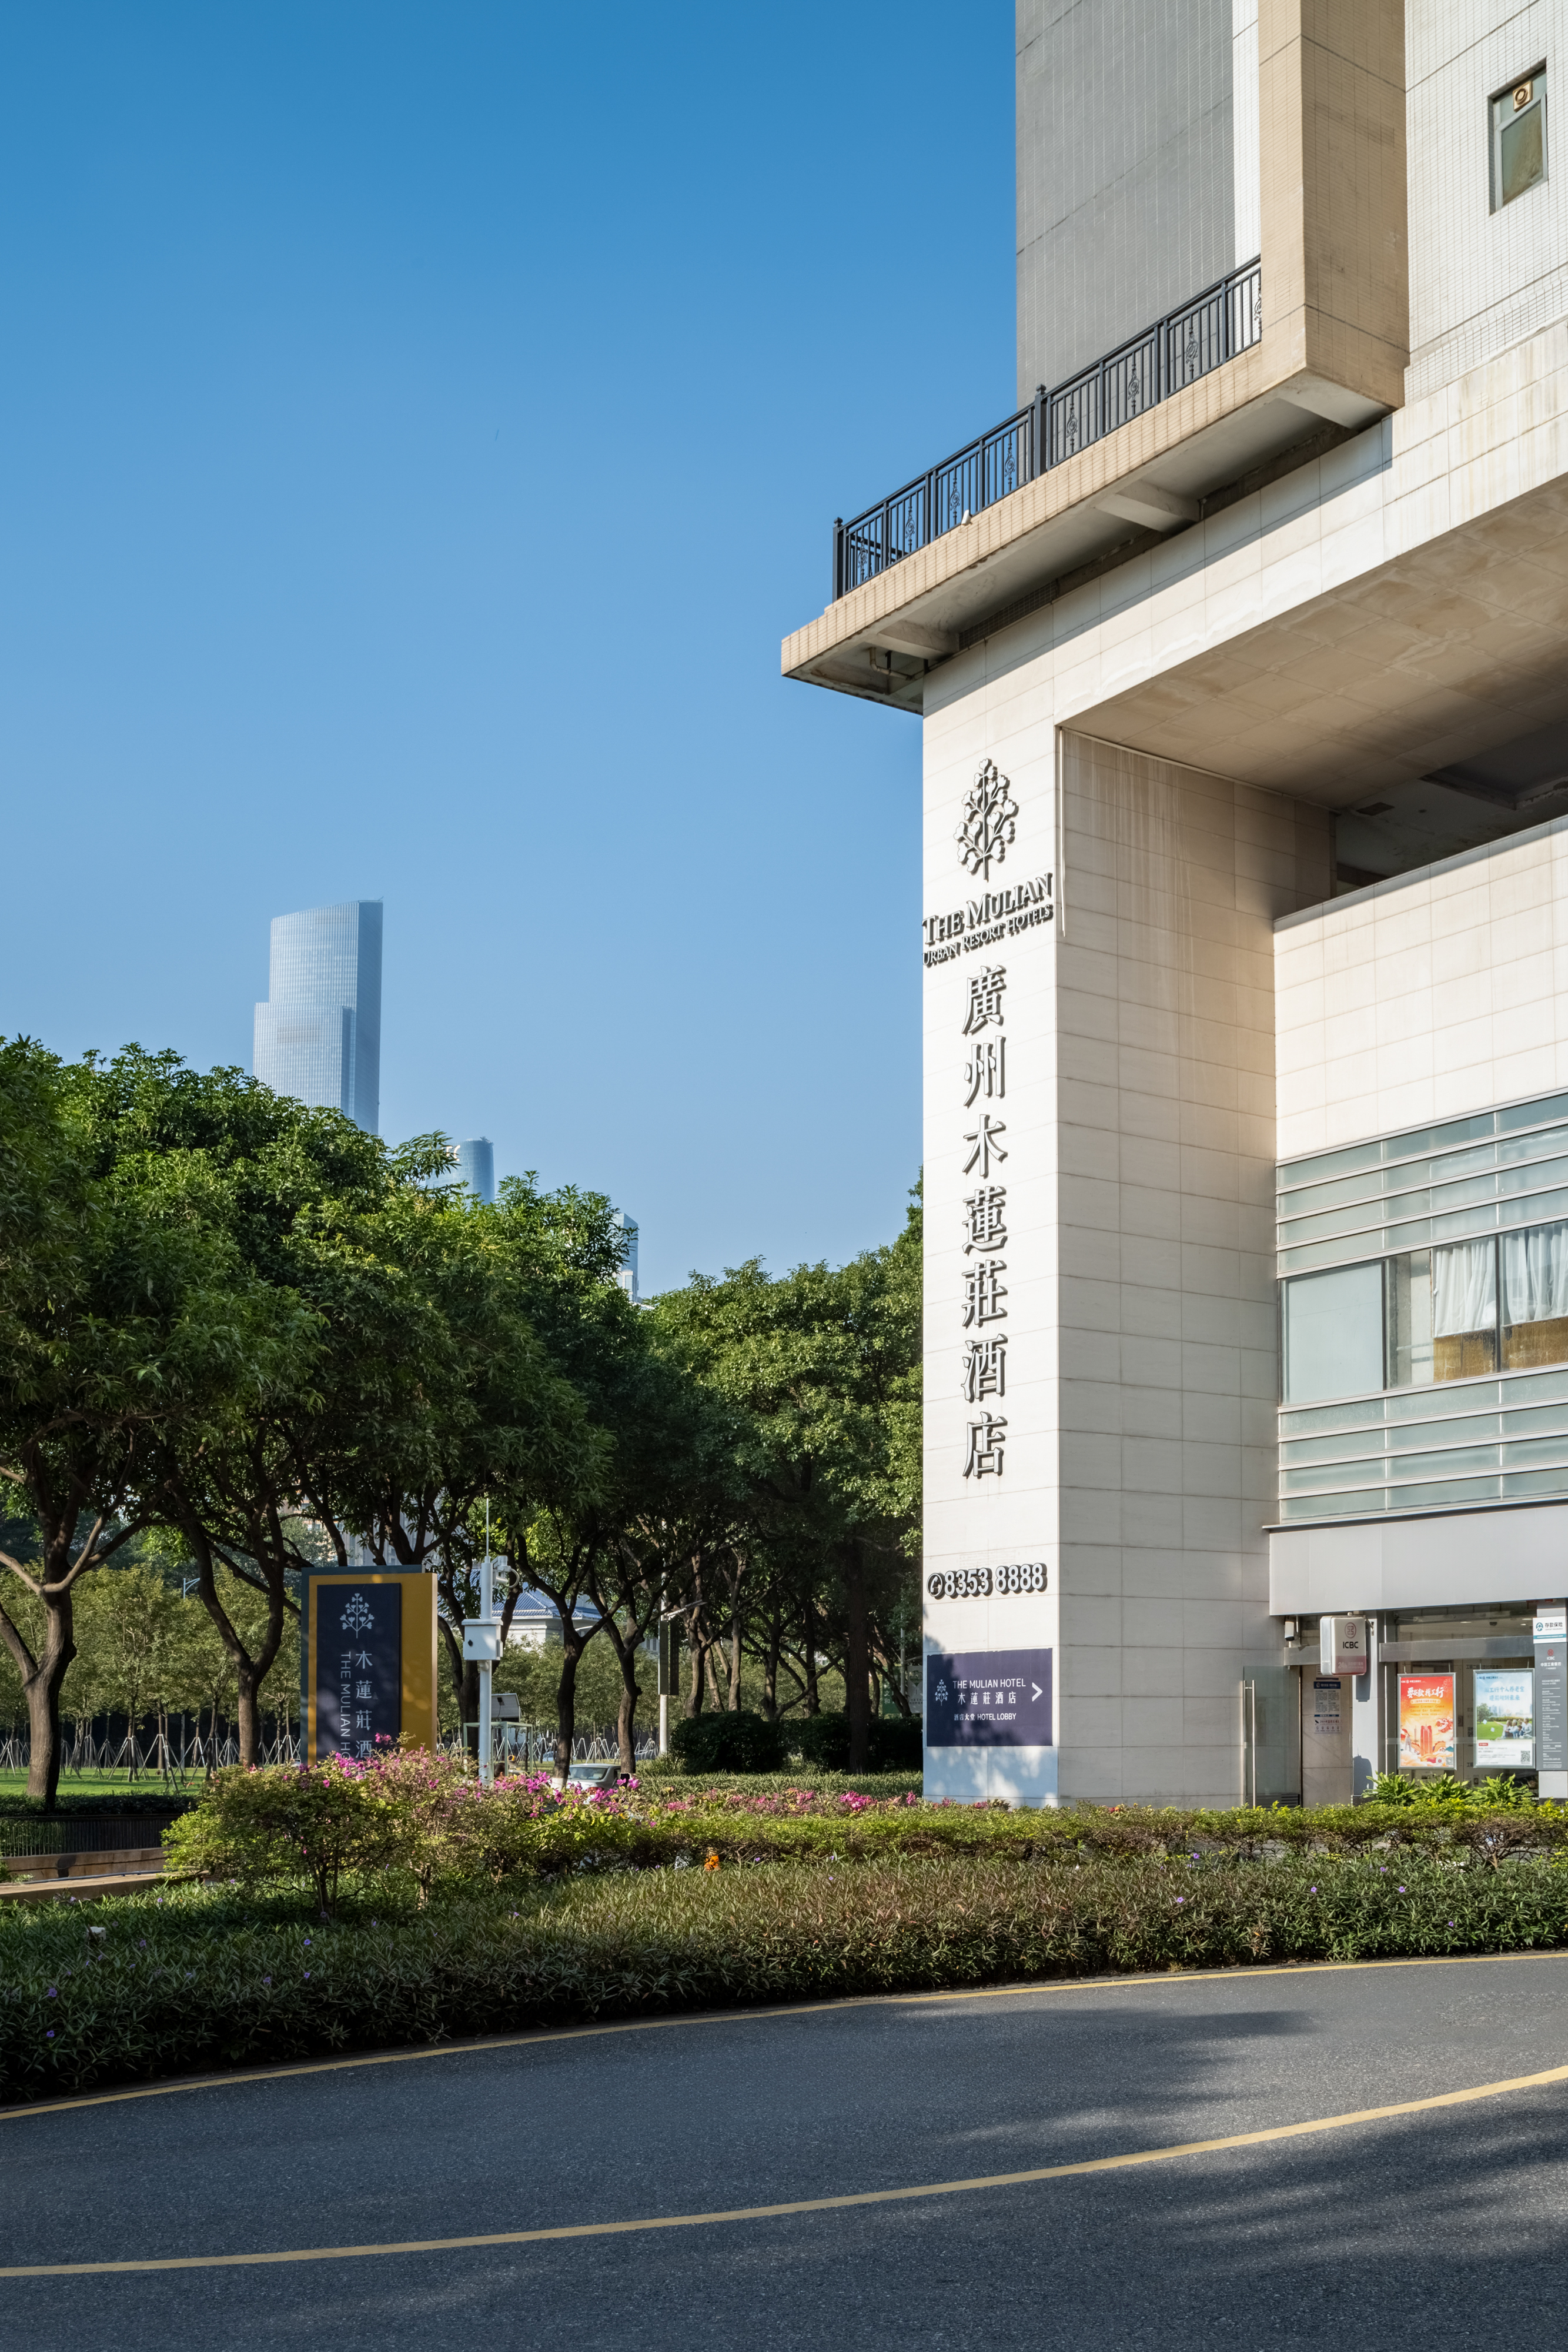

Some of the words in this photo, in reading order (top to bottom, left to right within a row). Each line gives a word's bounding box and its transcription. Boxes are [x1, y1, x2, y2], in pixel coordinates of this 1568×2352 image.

[922, 910, 964, 945] THE
[967, 873, 1053, 928] MULIAN
[922, 943, 961, 968] URBAN
[962, 923, 1006, 953] RESORT
[1007, 904, 1054, 936] HOTELS
[961, 964, 1008, 1479] 廣州木蓮莊酒店
[944, 1568, 994, 1599] 8353
[995, 1562, 1048, 1595] 8888
[340, 1651, 351, 1679] THE
[952, 1681, 967, 1689] THE
[969, 1679, 998, 1689] MULIAN
[1000, 1678, 1026, 1688] HOTEL
[957, 1691, 1017, 1705] 木蓮莊酒店
[340, 1684, 351, 1736] MULIAN
[954, 1713, 975, 1721] 酒店大堂
[997, 1712, 1017, 1720] LOBBY
